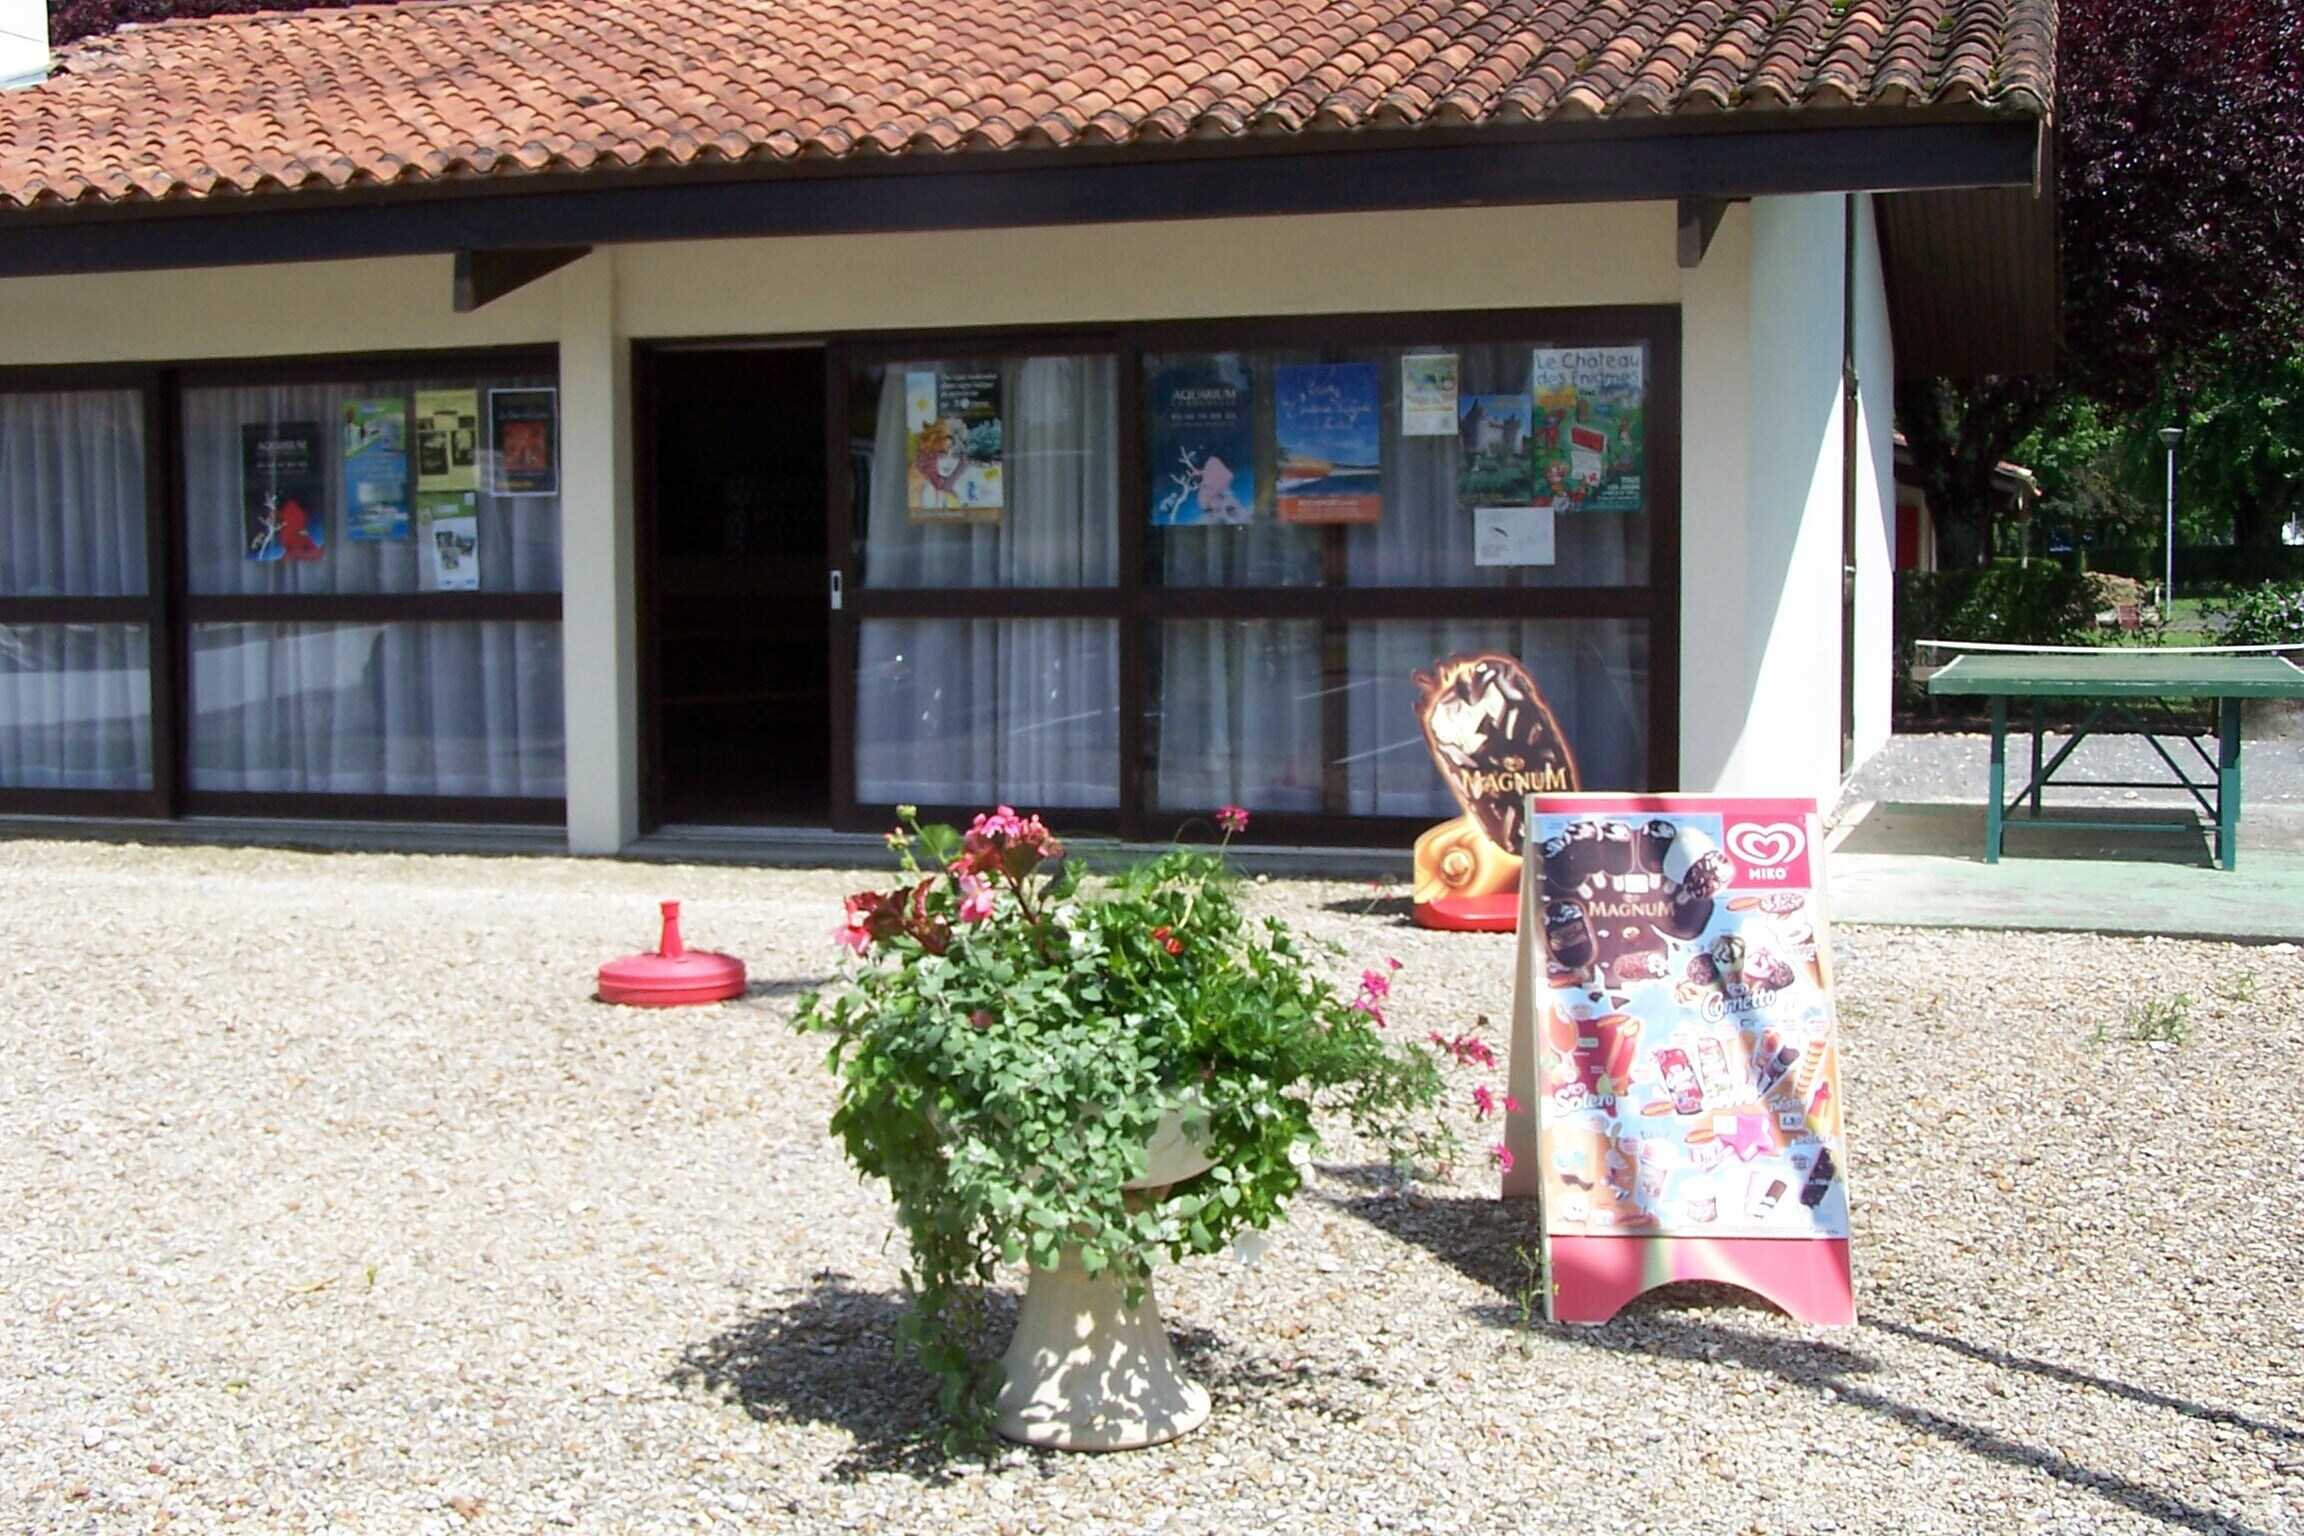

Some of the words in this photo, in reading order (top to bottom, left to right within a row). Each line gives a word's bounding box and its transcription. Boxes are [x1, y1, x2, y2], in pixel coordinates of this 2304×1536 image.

[1461, 765, 1567, 791] MAGNUM
[1748, 867, 1787, 880] MIKO
[1588, 901, 1676, 918] MAGNUM
[1702, 988, 1777, 1023] Cornetto
[1554, 1087, 1615, 1117] Solero
